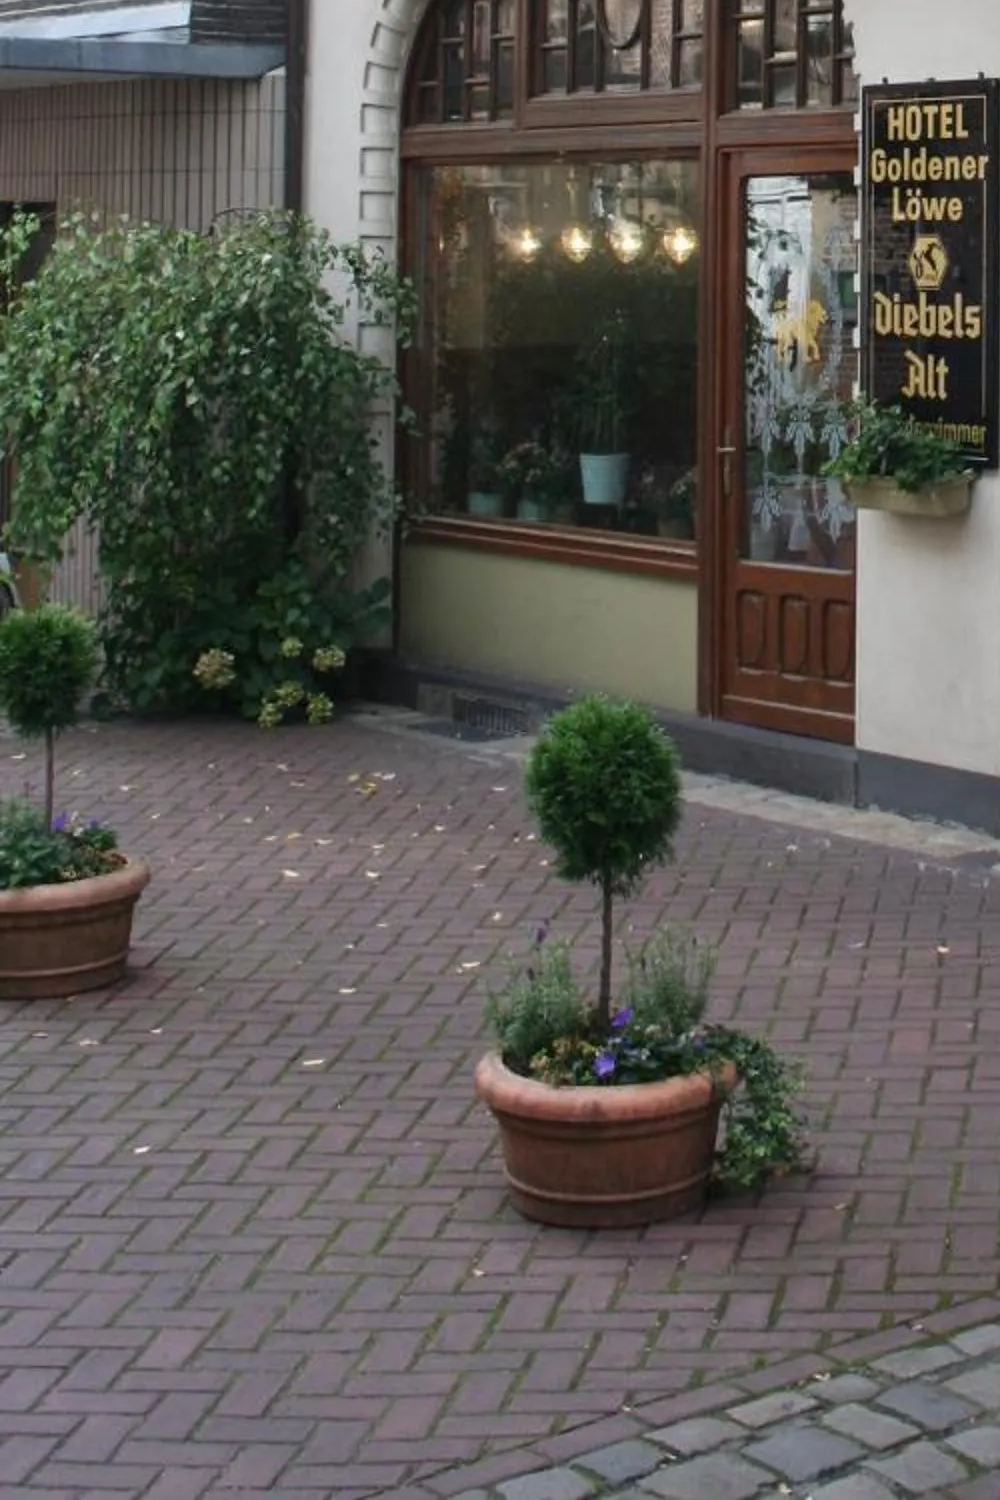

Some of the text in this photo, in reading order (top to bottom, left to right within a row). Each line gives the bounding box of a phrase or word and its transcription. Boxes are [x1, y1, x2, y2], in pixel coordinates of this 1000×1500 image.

[887, 103, 969, 141] HOTEL
[871, 146, 989, 183] Goldener
[892, 186, 963, 222] Löwe
[873, 291, 981, 339] Diebels
[901, 349, 949, 400] Alt
